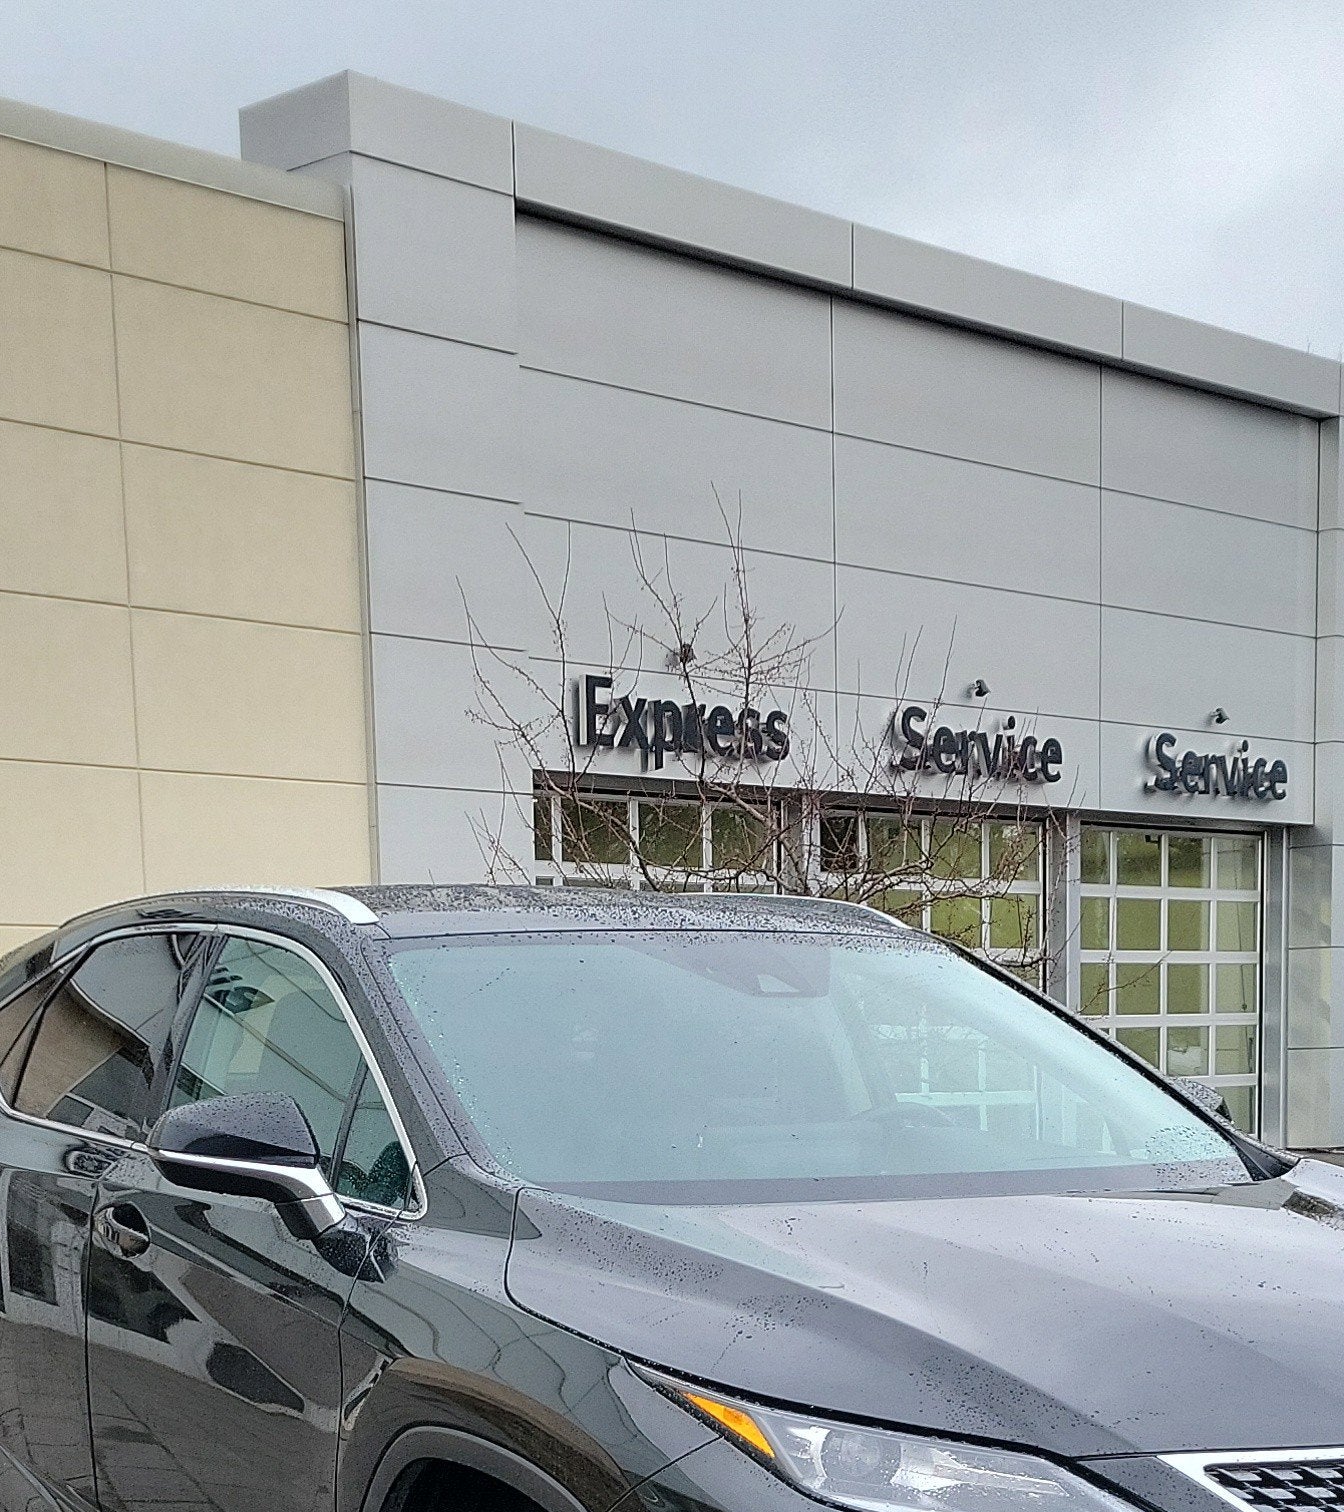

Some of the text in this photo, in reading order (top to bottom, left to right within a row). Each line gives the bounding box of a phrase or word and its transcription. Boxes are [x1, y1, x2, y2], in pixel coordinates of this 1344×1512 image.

[578, 674, 790, 772] Express
[896, 705, 1063, 783] Service
[1148, 732, 1288, 800] Service
